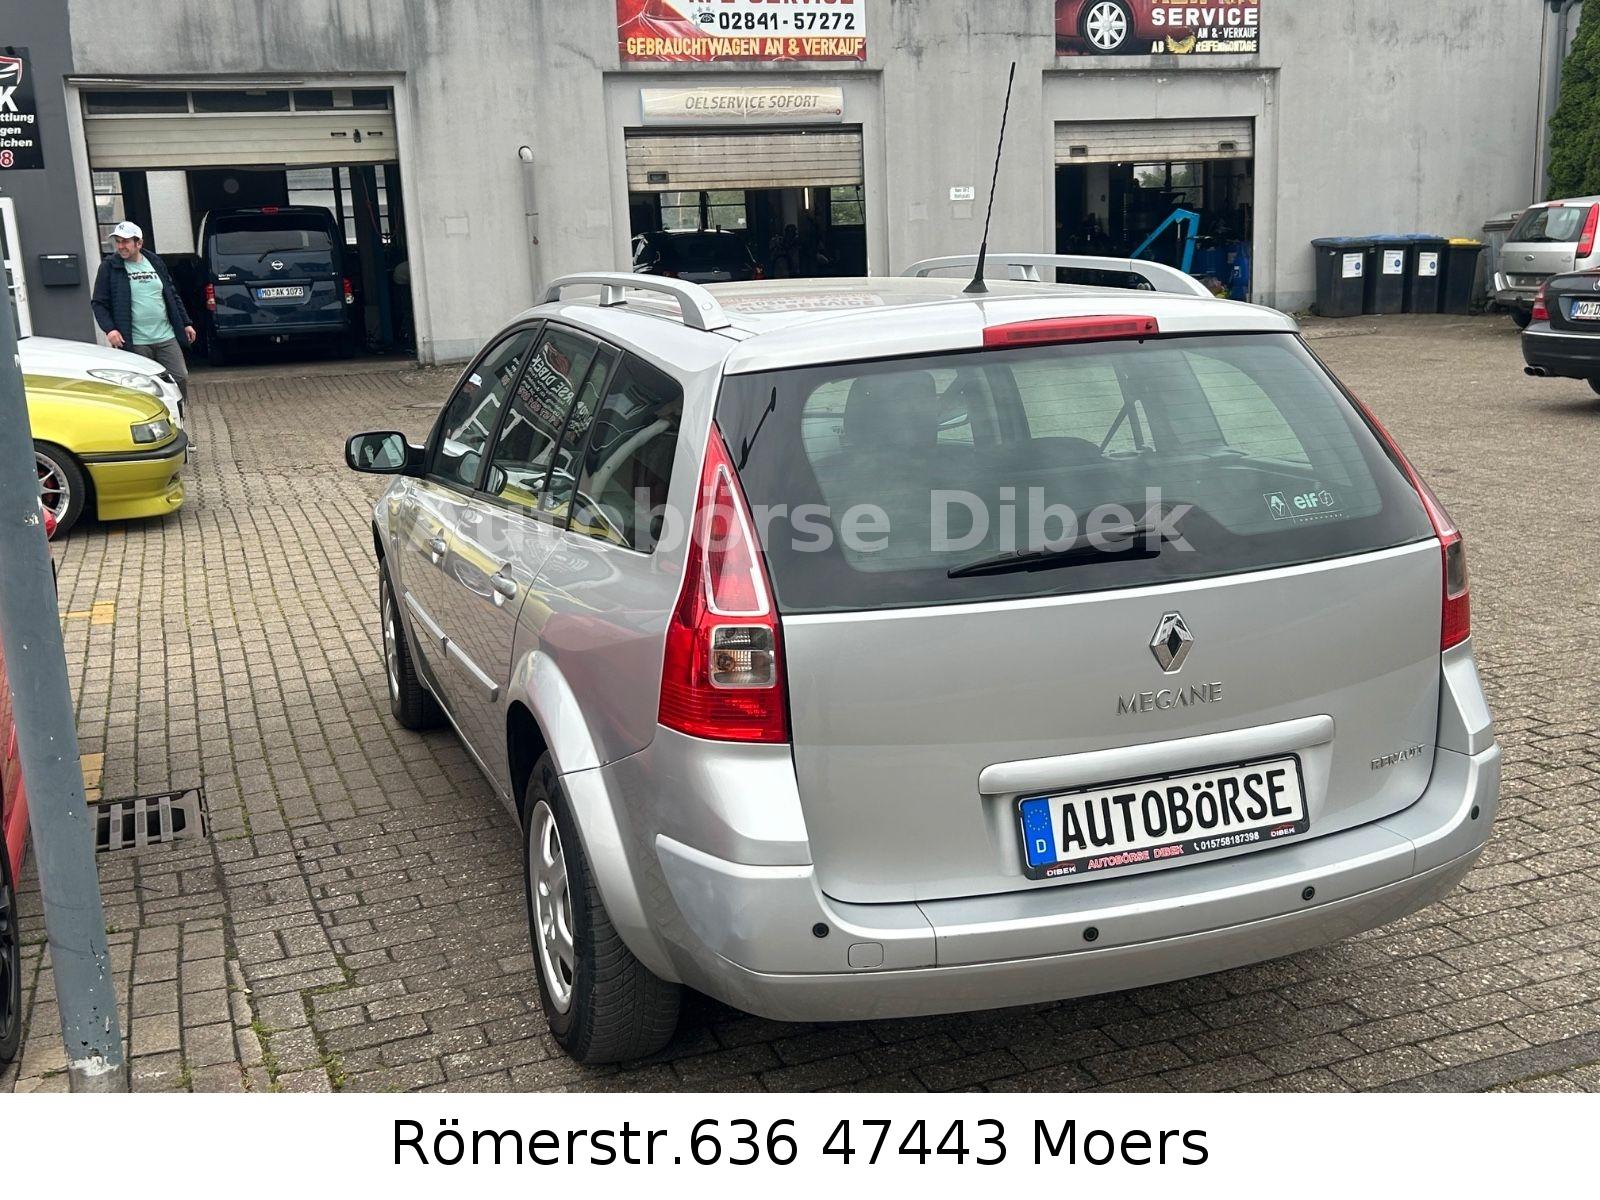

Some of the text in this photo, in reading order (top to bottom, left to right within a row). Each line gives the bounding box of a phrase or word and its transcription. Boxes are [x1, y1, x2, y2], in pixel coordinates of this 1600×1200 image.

[1151, 7, 1258, 26] SERVICE
[627, 37, 863, 57] GEBRAUCHTWAGEN AN & VERKAUF
[684, 94, 820, 110] OELSERVICE SOFORT
[1293, 492, 1319, 509] elf
[1117, 681, 1223, 716] MEGANE
[1036, 839, 1047, 853] D
[1046, 866, 1076, 876] DIBEK
[1087, 850, 1150, 870] AUTOBÖRSE
[1153, 844, 1184, 859] DIBEK
